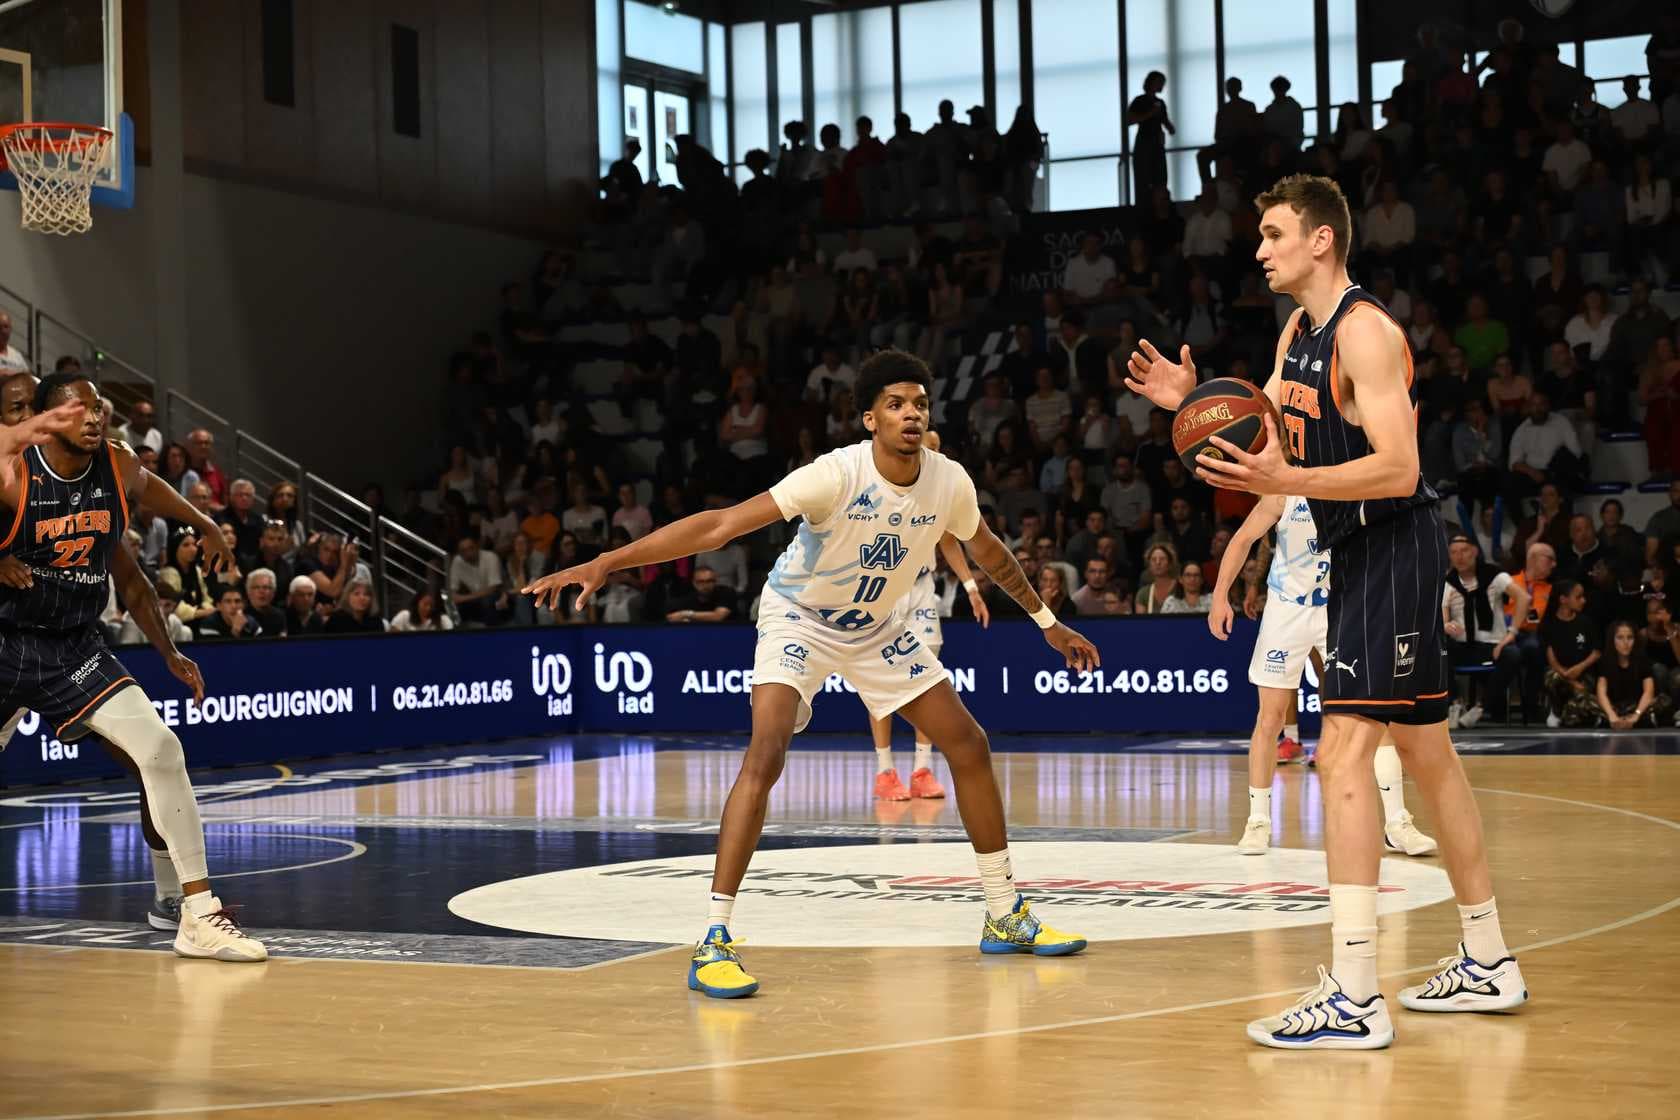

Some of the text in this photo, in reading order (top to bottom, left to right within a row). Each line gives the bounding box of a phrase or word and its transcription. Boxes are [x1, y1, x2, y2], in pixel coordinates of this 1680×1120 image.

[35, 510, 111, 544] POITIERS
[848, 513, 873, 522] VICHY
[49, 536, 95, 568] 22
[853, 575, 887, 603] 10
[71, 652, 102, 680] GRAPHIC
[681, 669, 753, 694] ALICE
[1034, 668, 1229, 694] 06.21.40.81.66
[185, 686, 353, 725] BOURGUIGNON
[392, 679, 513, 711] 06.21.40.81.66
[547, 693, 573, 717] iad
[618, 691, 654, 714] iad
[1297, 689, 1321, 712] ia
